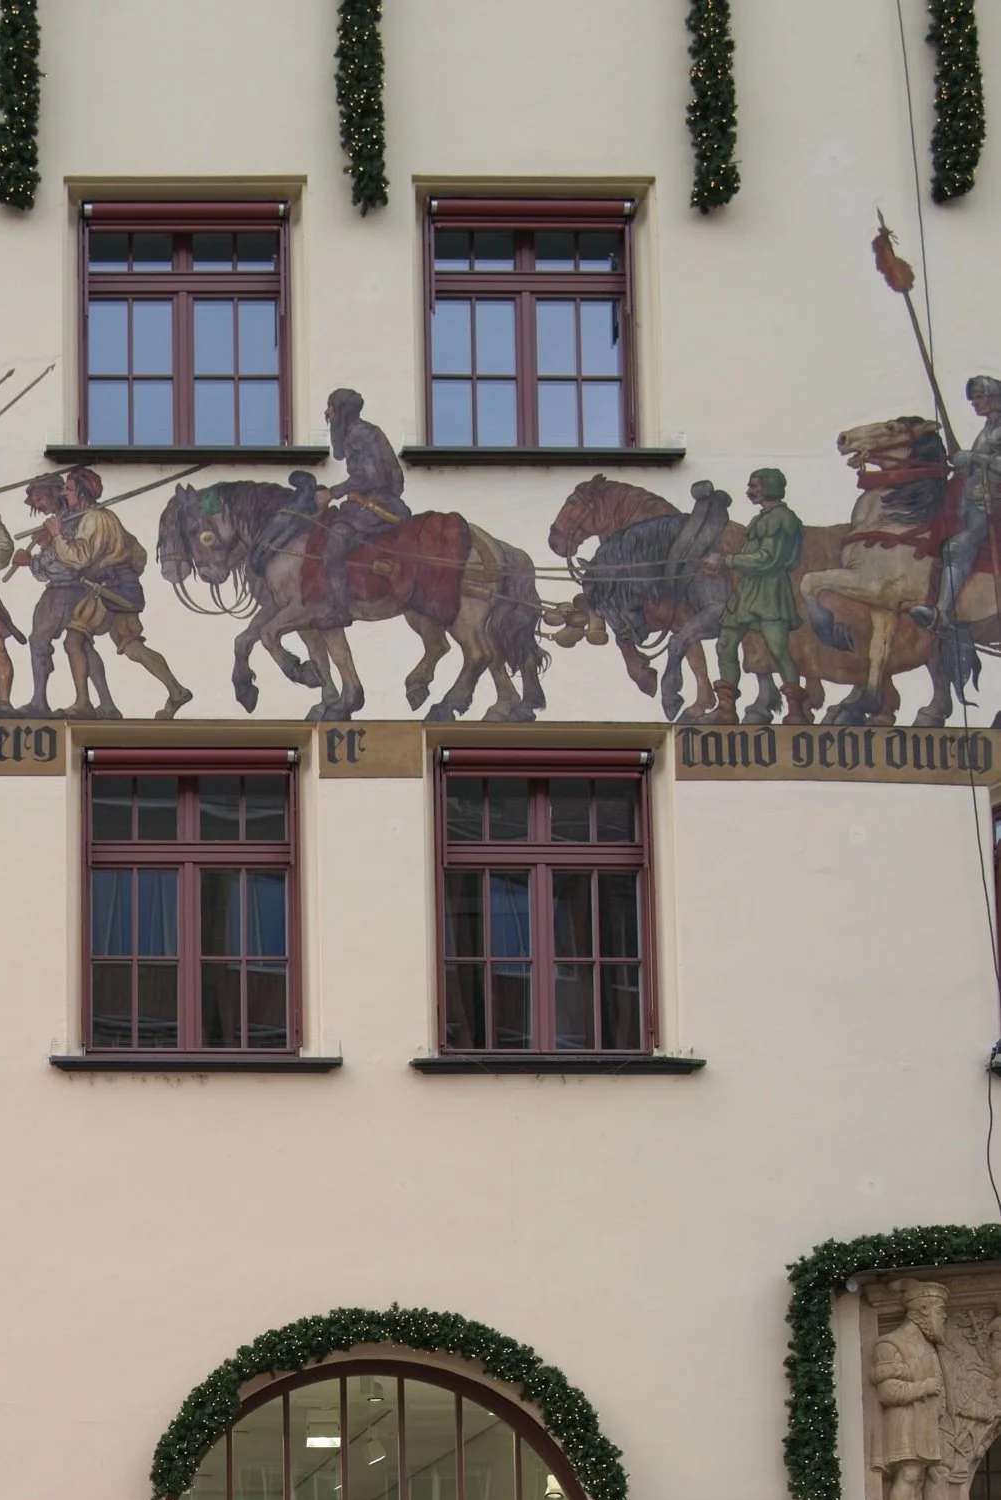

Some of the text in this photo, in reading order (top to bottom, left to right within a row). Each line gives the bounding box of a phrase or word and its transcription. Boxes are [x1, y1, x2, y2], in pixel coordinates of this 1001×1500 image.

[326, 727, 366, 764] er
[792, 727, 876, 770] geht
[885, 728, 992, 774] durch
